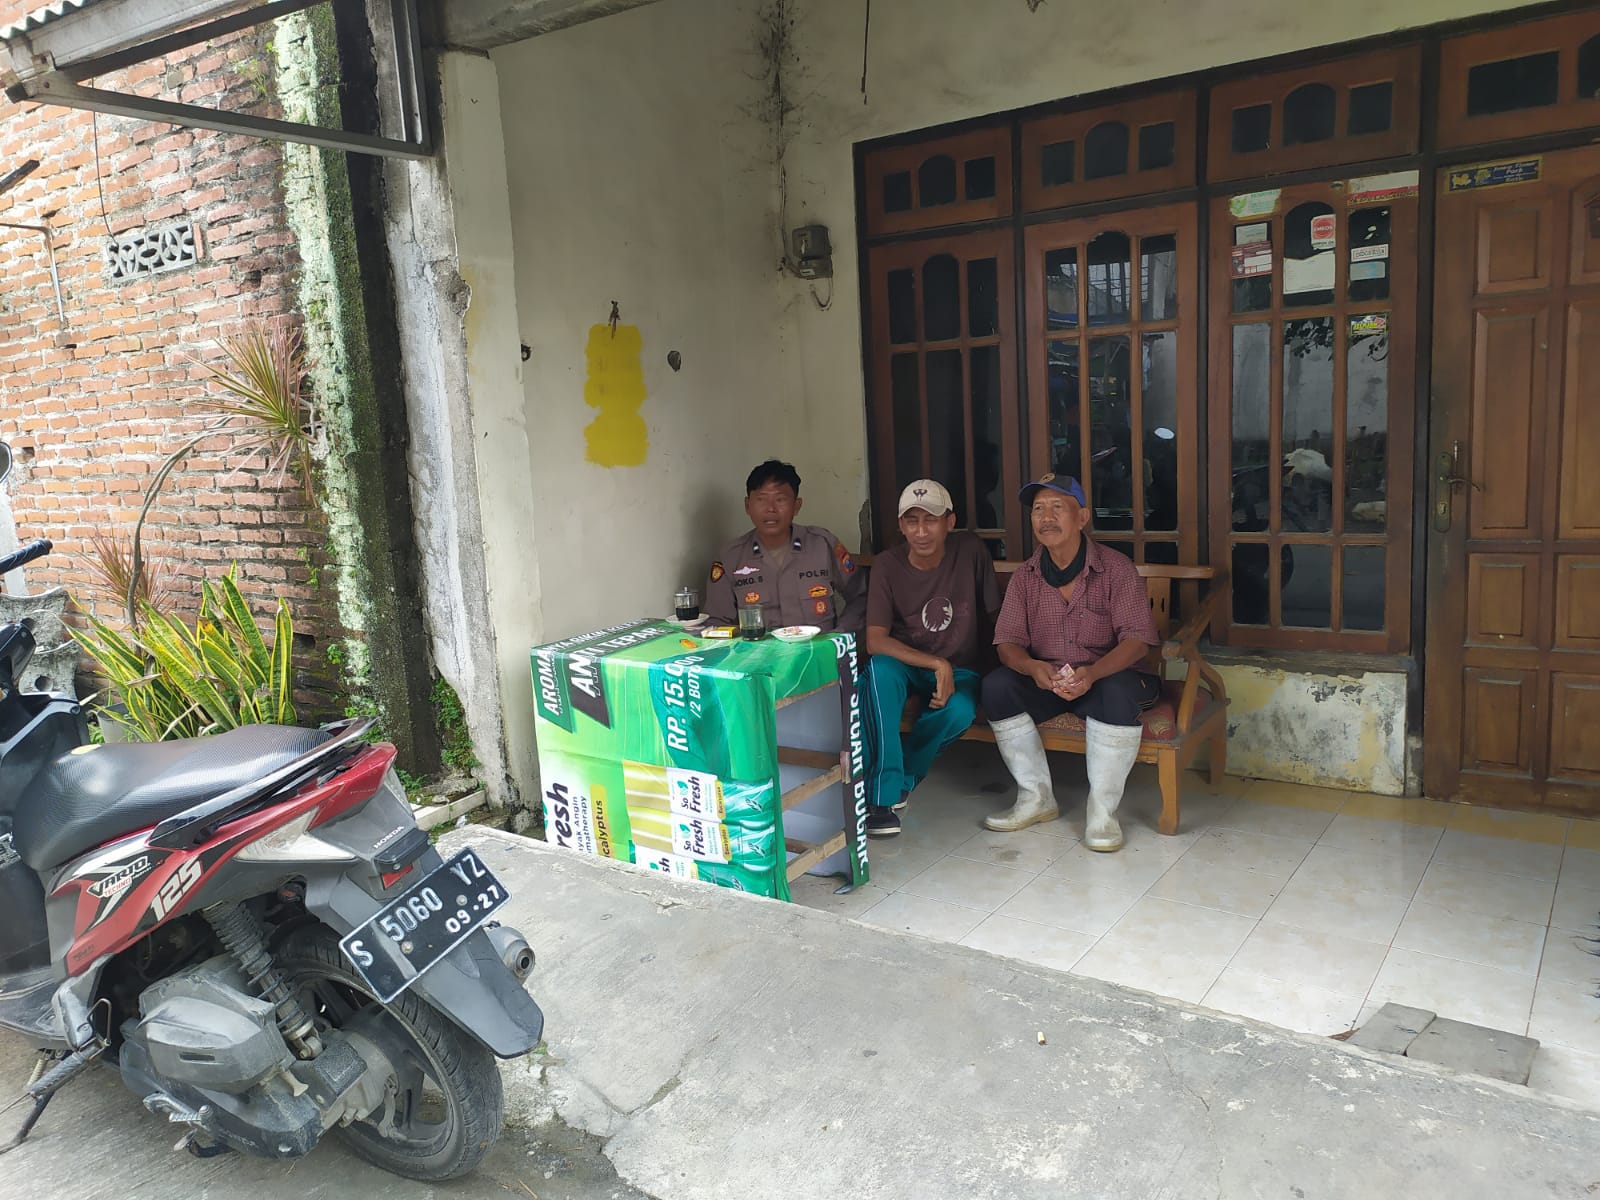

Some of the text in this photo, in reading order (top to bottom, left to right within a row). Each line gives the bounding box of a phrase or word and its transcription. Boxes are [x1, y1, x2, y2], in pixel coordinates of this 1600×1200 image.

[799, 569, 829, 579] POLRI
[663, 655, 705, 752] RP. 15.000
[689, 701, 702, 719] /2
[572, 796, 580, 828] Angin
[681, 797, 689, 809] So
[688, 776, 701, 813] Fresh
[546, 782, 573, 848] resh
[580, 795, 593, 854] matherapy
[373, 825, 405, 849] HONDA
[683, 840, 692, 852] So
[690, 819, 706, 856] Fresh
[87, 856, 148, 898] VARIO
[103, 877, 132, 896] TECHNO
[151, 855, 202, 922] 125
[350, 940, 374, 967] S
[380, 887, 443, 942] 5060
